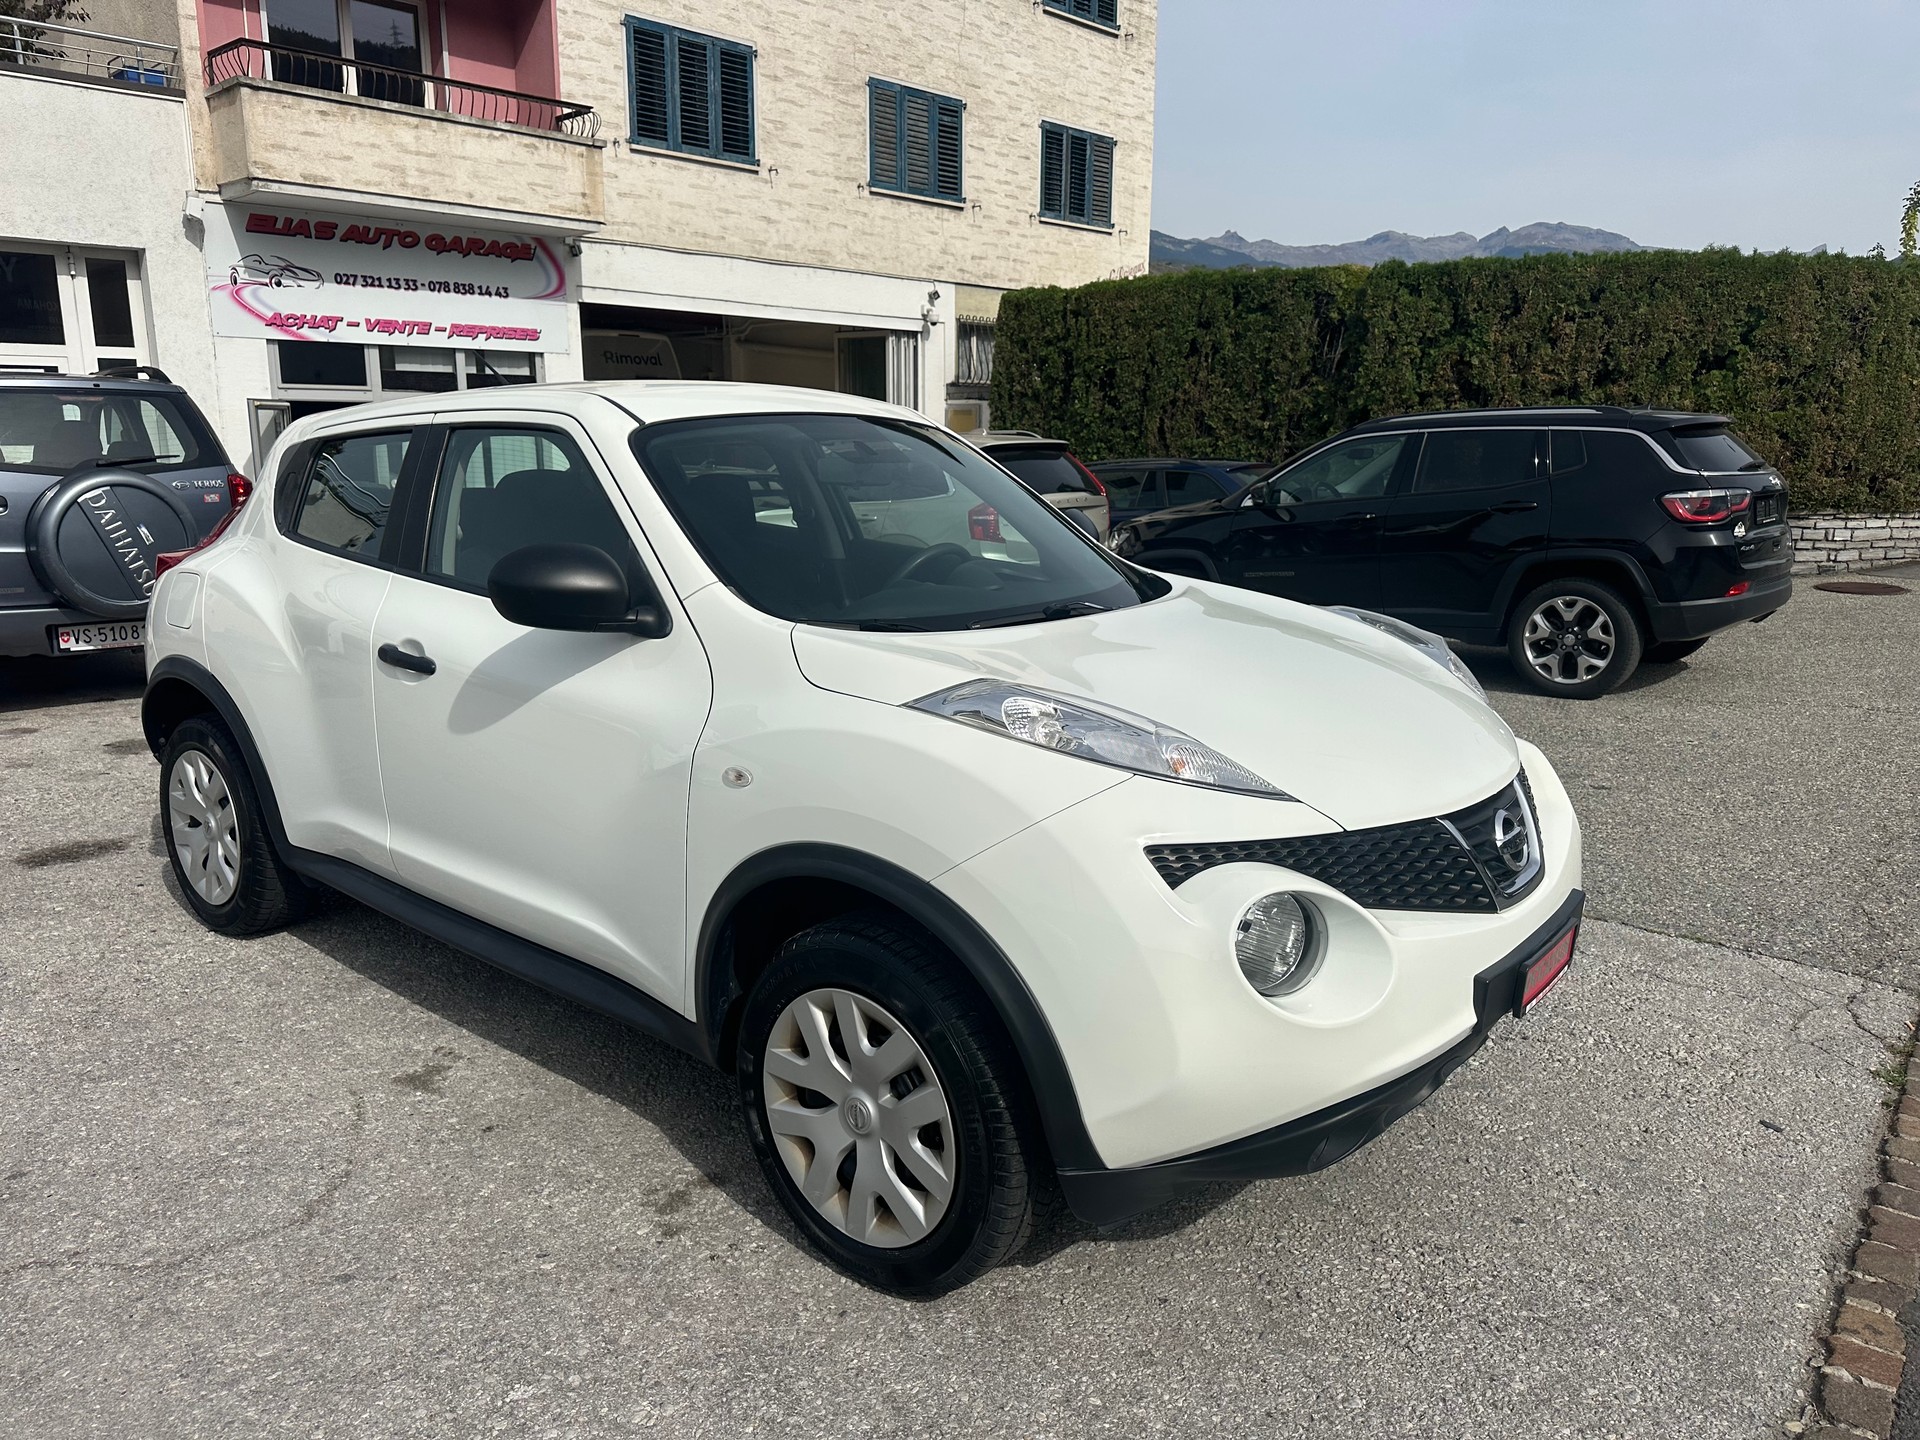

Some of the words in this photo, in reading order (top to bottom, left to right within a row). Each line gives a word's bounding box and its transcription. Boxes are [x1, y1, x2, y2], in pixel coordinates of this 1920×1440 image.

[245, 212, 338, 240] ELIAS
[340, 223, 420, 251] AUTO
[424, 232, 537, 263] GARAGE
[333, 272, 358, 288] 027
[360, 274, 384, 289] 321
[386, 277, 401, 290] 13
[403, 278, 419, 291] 33
[427, 280, 451, 294] 078
[452, 281, 475, 296] 838
[477, 284, 492, 298] 14
[494, 285, 510, 299] 43
[265, 312, 343, 333] ACHAT
[364, 317, 432, 338] VENTE
[447, 322, 541, 342] REPRISES
[603, 350, 663, 367] Rimoval
[191, 479, 225, 489] TERIOS
